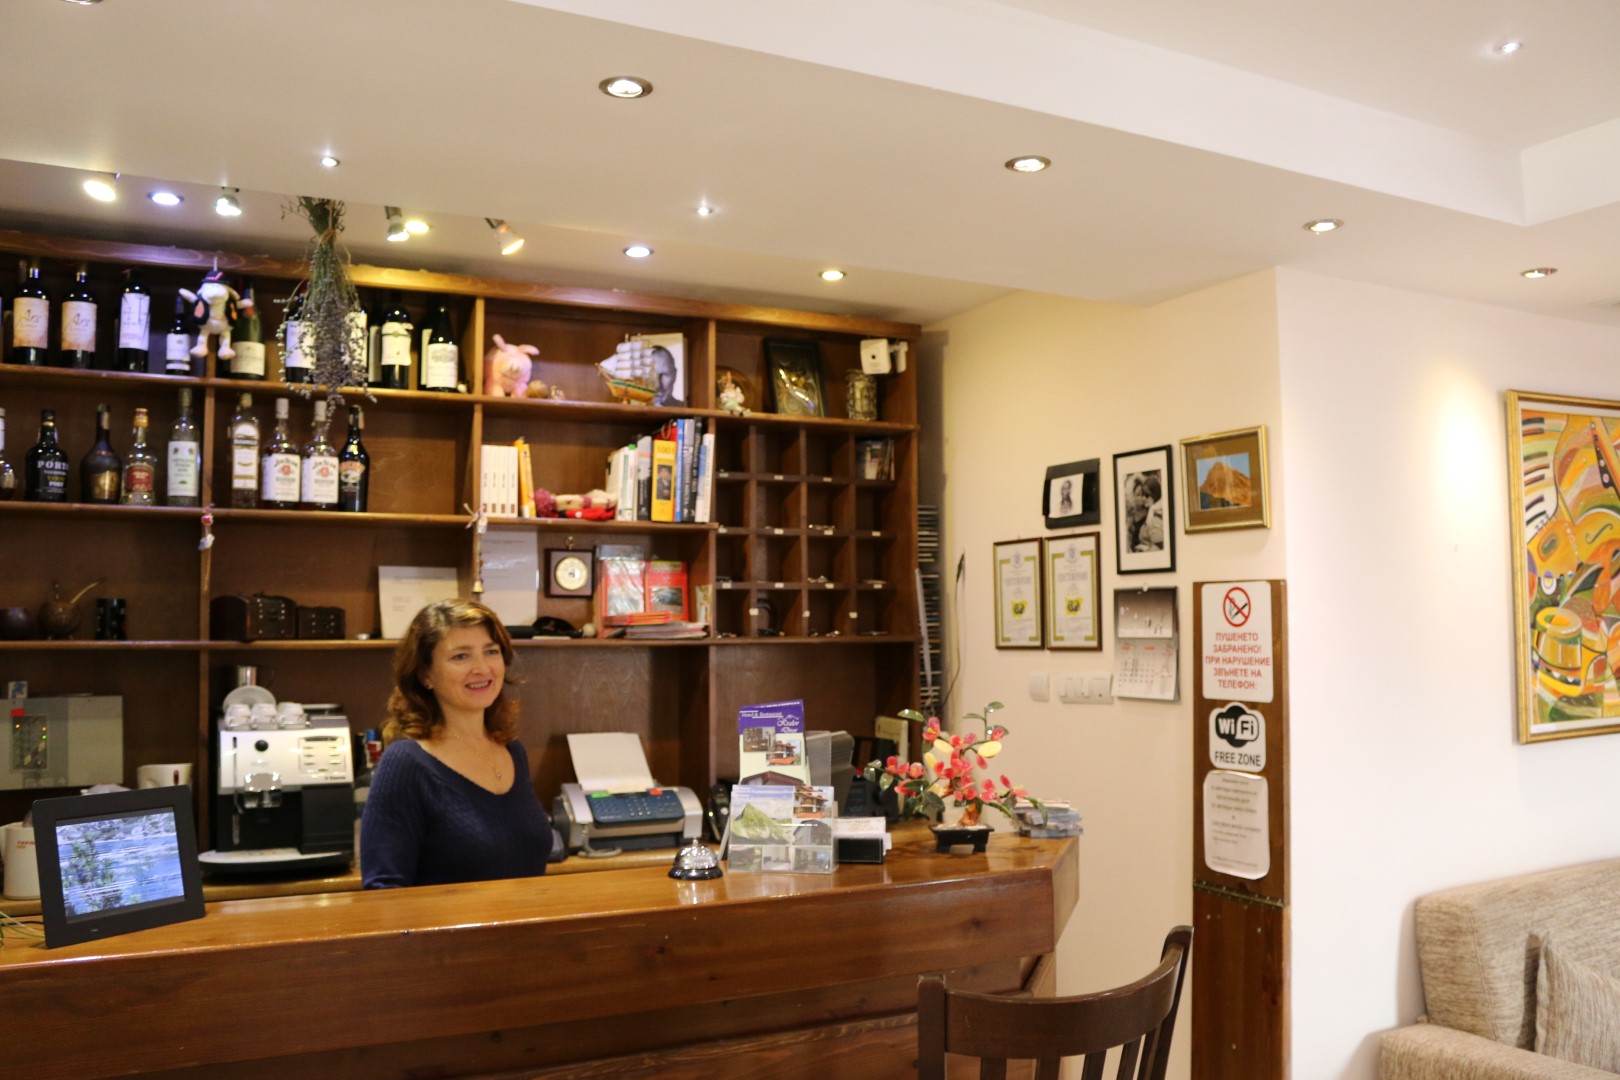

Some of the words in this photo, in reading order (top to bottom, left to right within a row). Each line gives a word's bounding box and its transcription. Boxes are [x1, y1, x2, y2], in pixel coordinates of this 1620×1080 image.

[1215, 632, 1258, 642] ПУШЕНЕТО
[1213, 644, 1262, 654] ЗАБРАНЕНО!
[1205, 655, 1221, 665] ПРИ
[1222, 656, 1271, 666] НАРУШЕНИЕ
[1213, 667, 1249, 677] ЗВЪНЕТЕ
[1250, 668, 1262, 678] НА
[1214, 751, 1236, 765] FREE
[1237, 753, 1262, 767] ZONE
